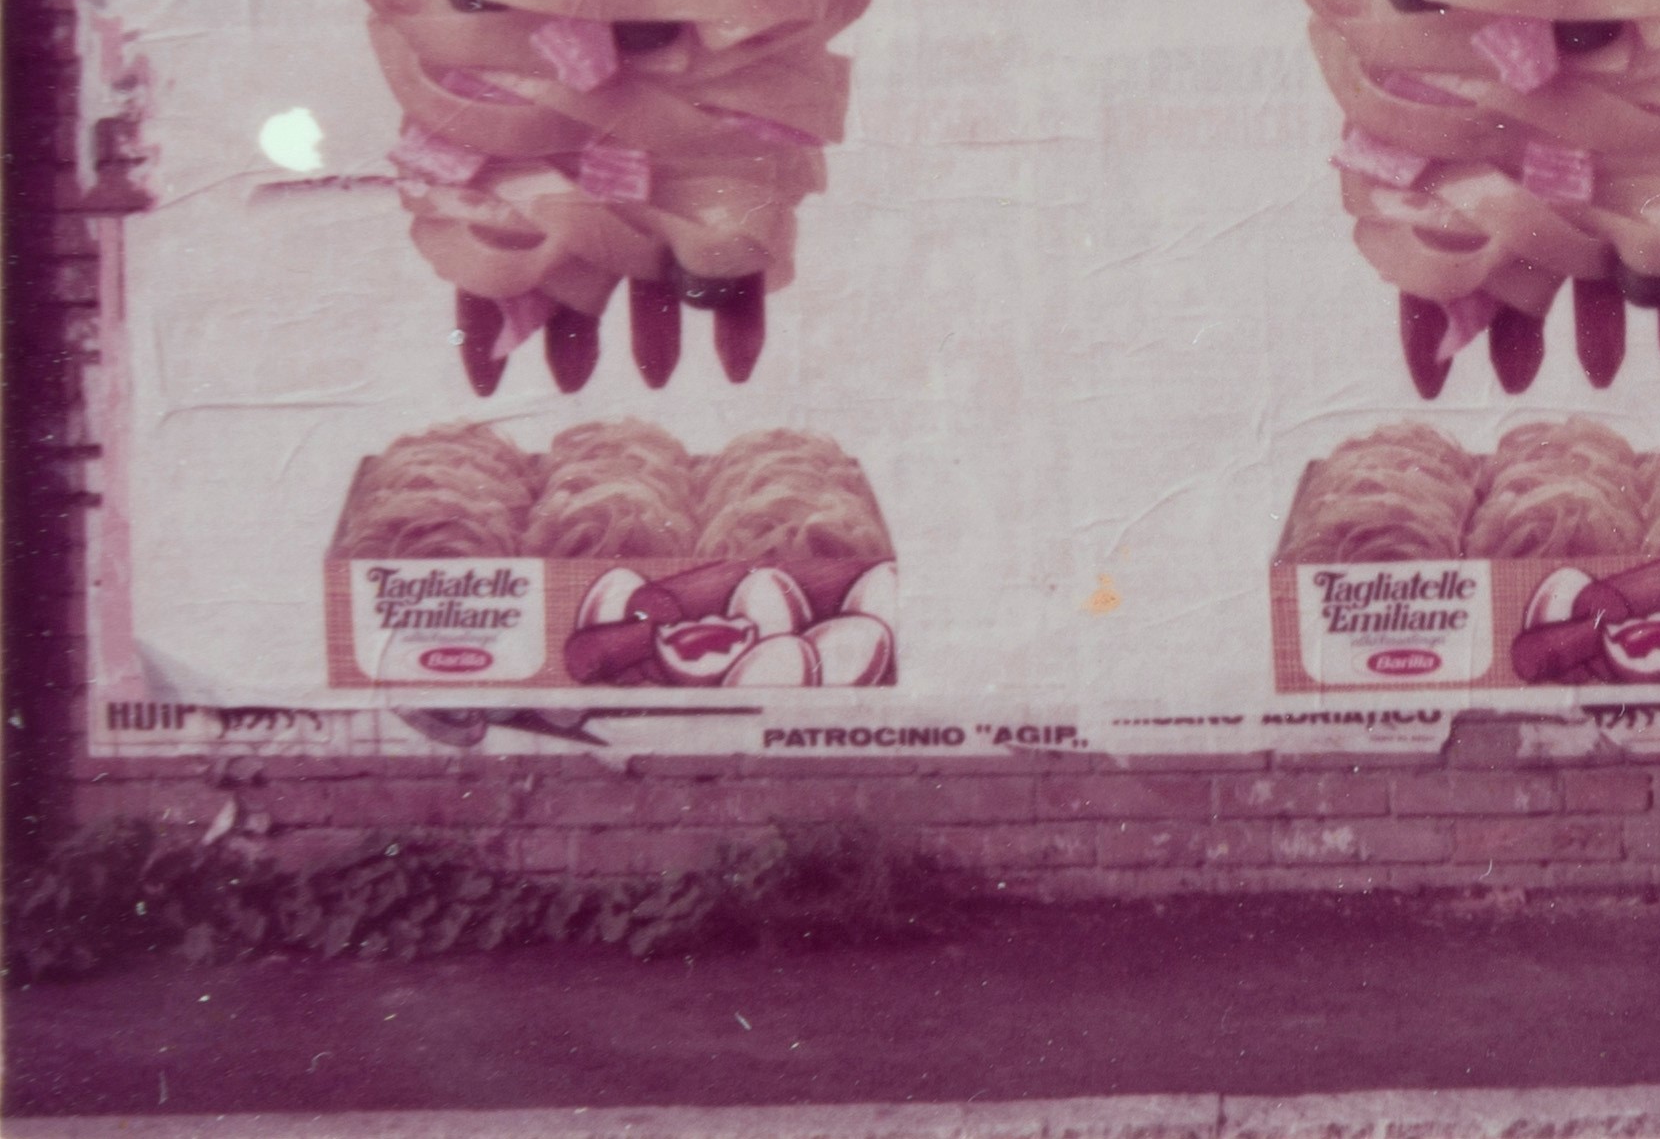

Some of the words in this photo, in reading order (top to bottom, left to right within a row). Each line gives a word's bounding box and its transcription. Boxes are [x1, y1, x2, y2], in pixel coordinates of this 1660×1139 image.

[367, 567, 529, 605] Tagliatelle
[1313, 570, 1476, 608] Tagliatelle
[375, 601, 521, 629] Emiliane
[1322, 604, 1468, 632] Emiliane
[763, 727, 965, 748] PATROCINIO
